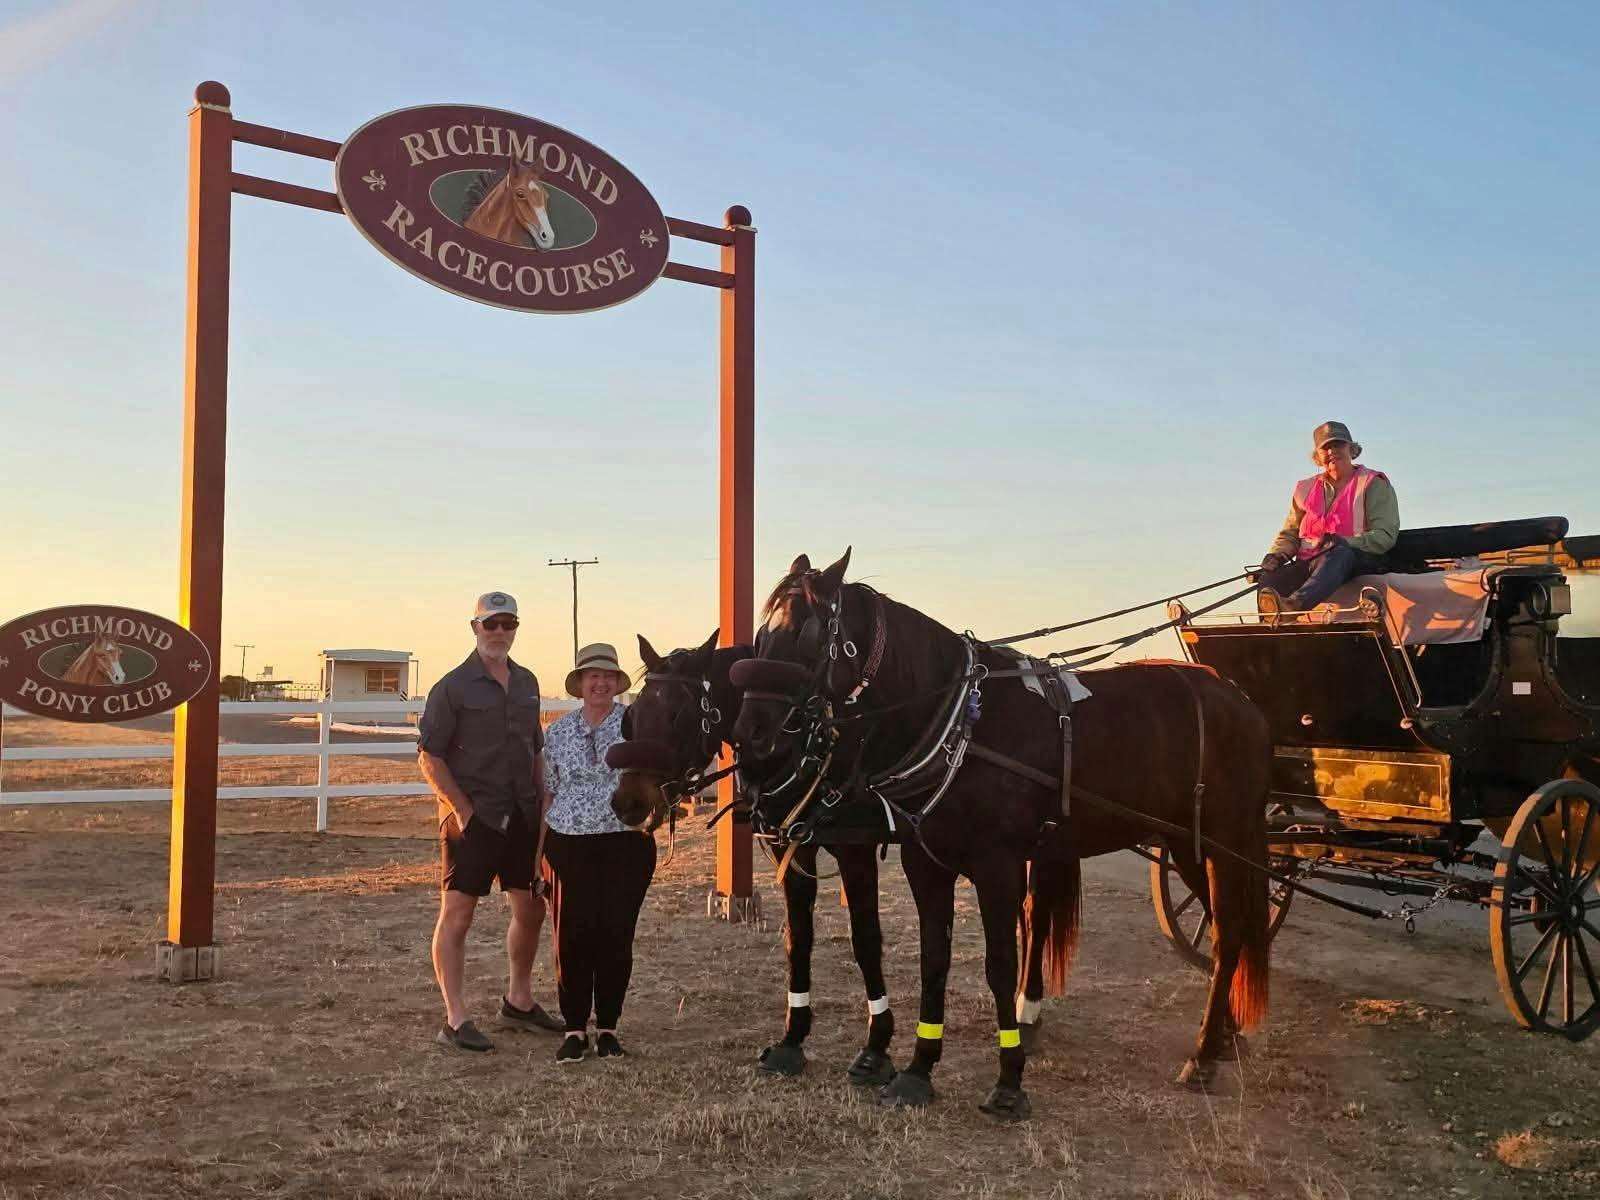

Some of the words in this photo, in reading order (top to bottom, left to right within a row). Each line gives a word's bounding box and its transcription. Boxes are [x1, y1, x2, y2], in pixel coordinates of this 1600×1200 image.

[400, 124, 619, 206] RICHMOND
[382, 200, 636, 297] RACECOURSE
[18, 615, 173, 651] RICHMOND
[16, 677, 96, 715] PONY
[103, 680, 173, 715] CLUB
